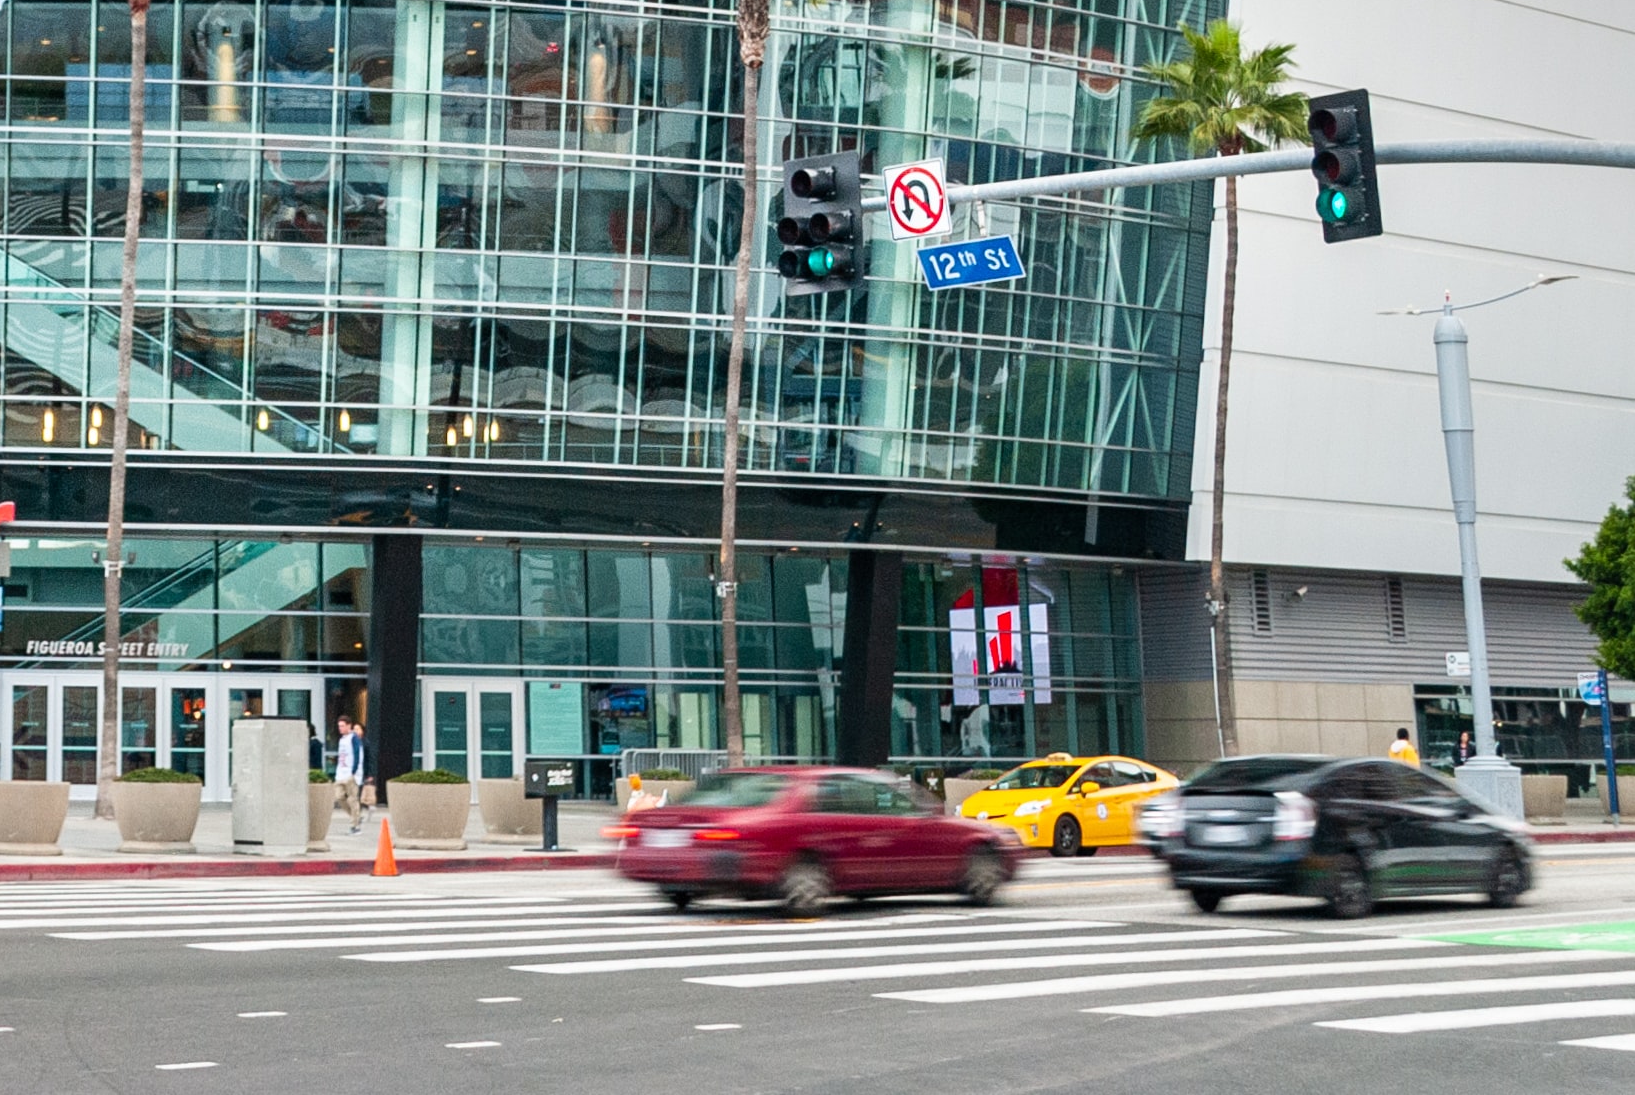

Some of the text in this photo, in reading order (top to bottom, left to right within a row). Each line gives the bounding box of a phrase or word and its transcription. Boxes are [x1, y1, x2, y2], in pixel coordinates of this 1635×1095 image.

[928, 247, 1011, 280] 12th St
[26, 640, 189, 657] FIGUEROA SEET ENTRY
